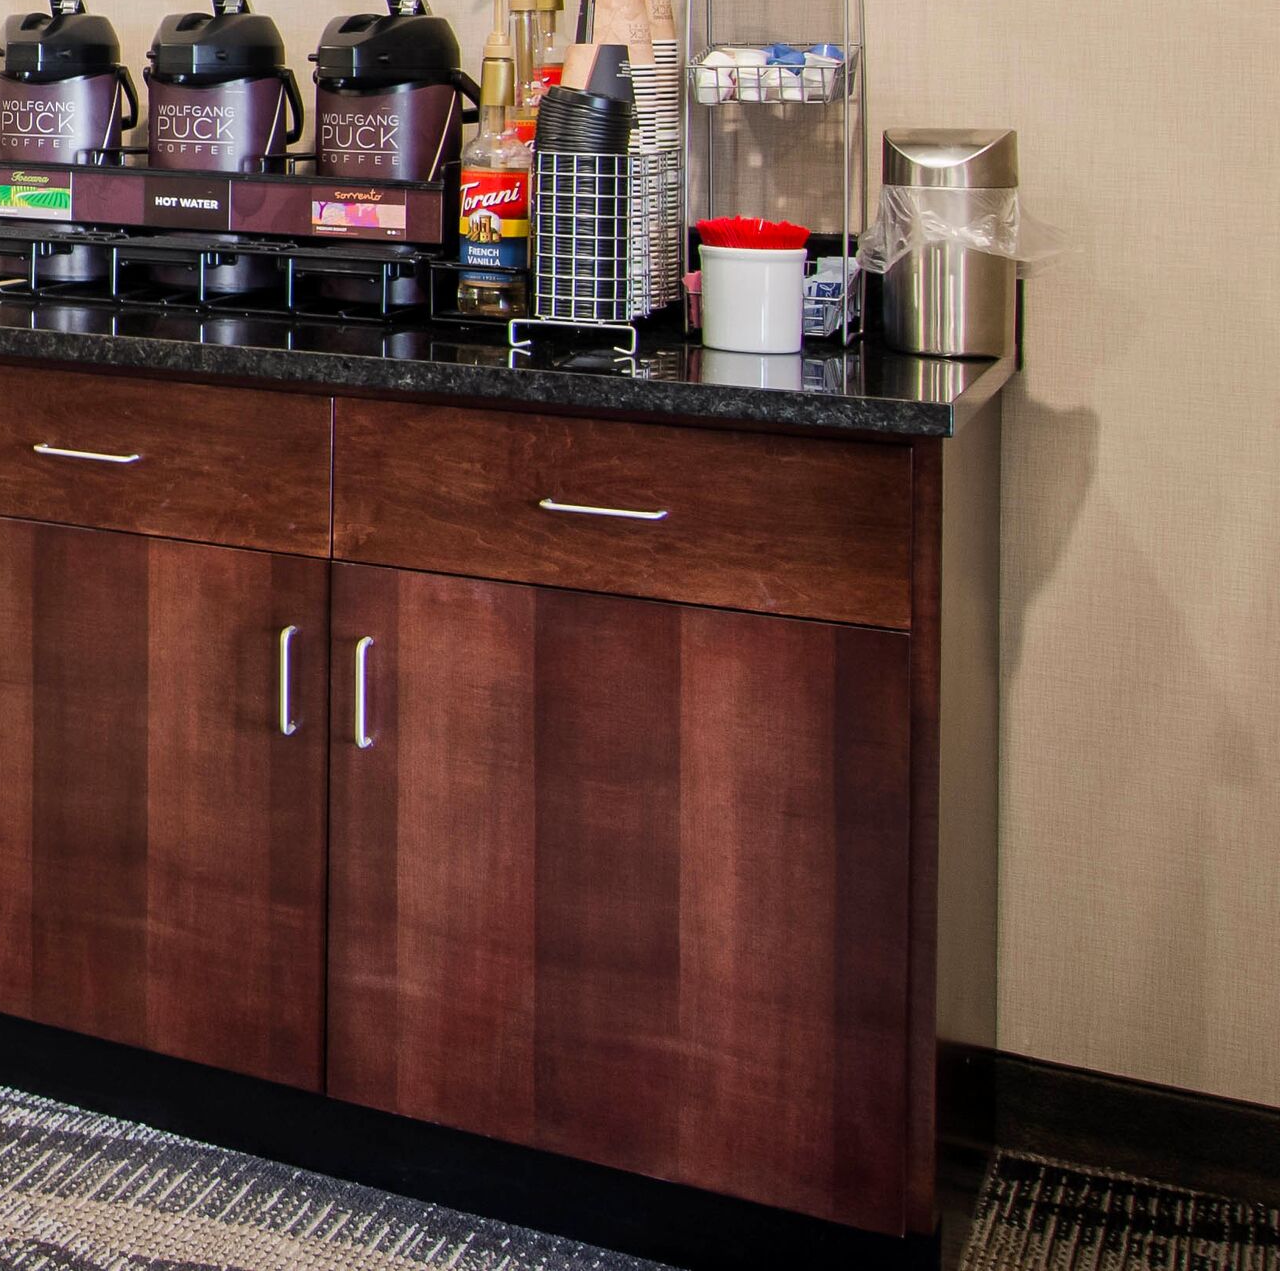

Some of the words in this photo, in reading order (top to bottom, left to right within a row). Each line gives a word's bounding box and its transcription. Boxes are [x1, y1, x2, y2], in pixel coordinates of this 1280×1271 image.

[2, 100, 76, 112] WOLFGANG
[158, 104, 235, 117] WOLFGANG
[1, 111, 75, 133] PUCK
[322, 113, 400, 126] WOLFGANG
[158, 116, 234, 139] PUCK
[1, 137, 78, 149] COFFEE
[322, 125, 400, 148] PUCK
[157, 143, 234, 155] COFFEE
[322, 153, 400, 165] COFFEE
[155, 196, 178, 207] HOT
[179, 197, 218, 209] WATER
[460, 182, 520, 217] Torani
[468, 246, 499, 257] FRENCH
[467, 255, 500, 267] VANILLA
